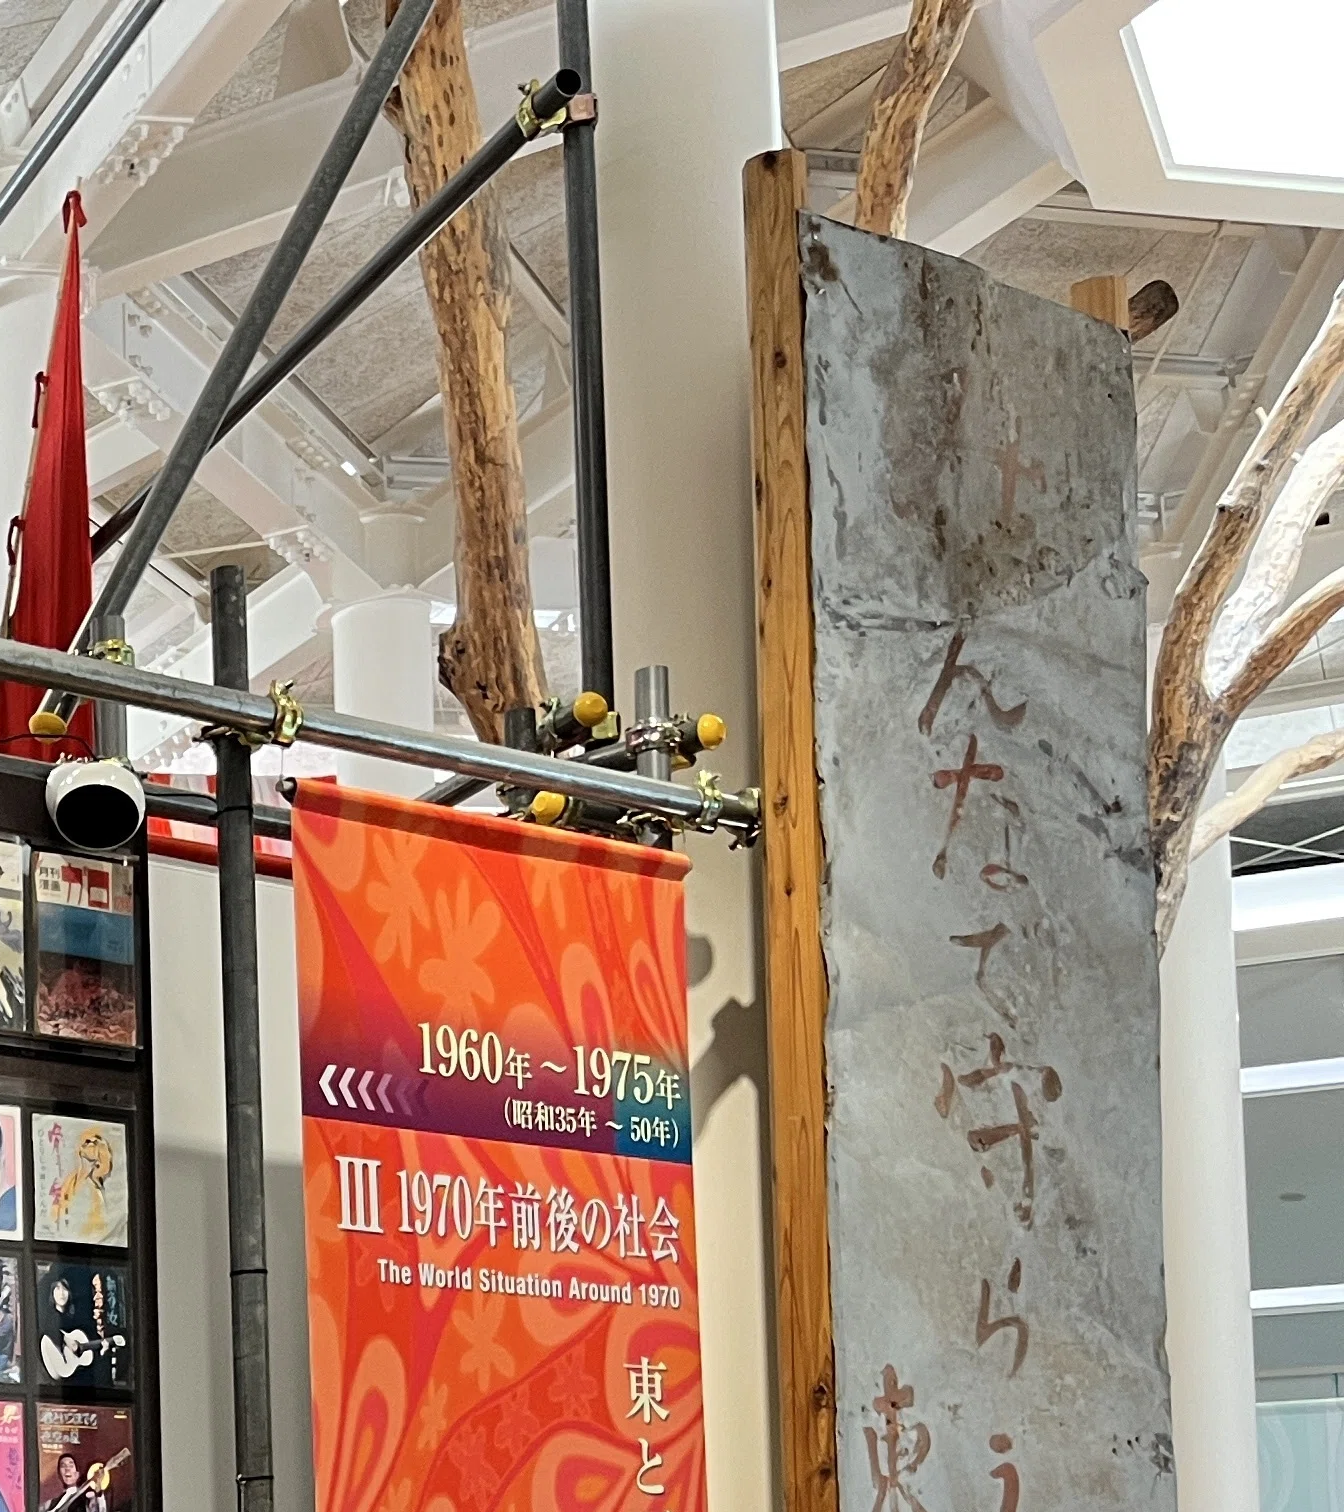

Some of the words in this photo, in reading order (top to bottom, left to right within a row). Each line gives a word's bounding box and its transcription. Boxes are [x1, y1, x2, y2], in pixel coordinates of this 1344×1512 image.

[396, 1170, 680, 1263] 1970年前後の社会
[377, 1258, 411, 1285] The
[420, 1264, 472, 1290] World
[479, 1269, 563, 1298] Situation
[569, 1277, 632, 1304] Around
[639, 1285, 680, 1308] 1970
